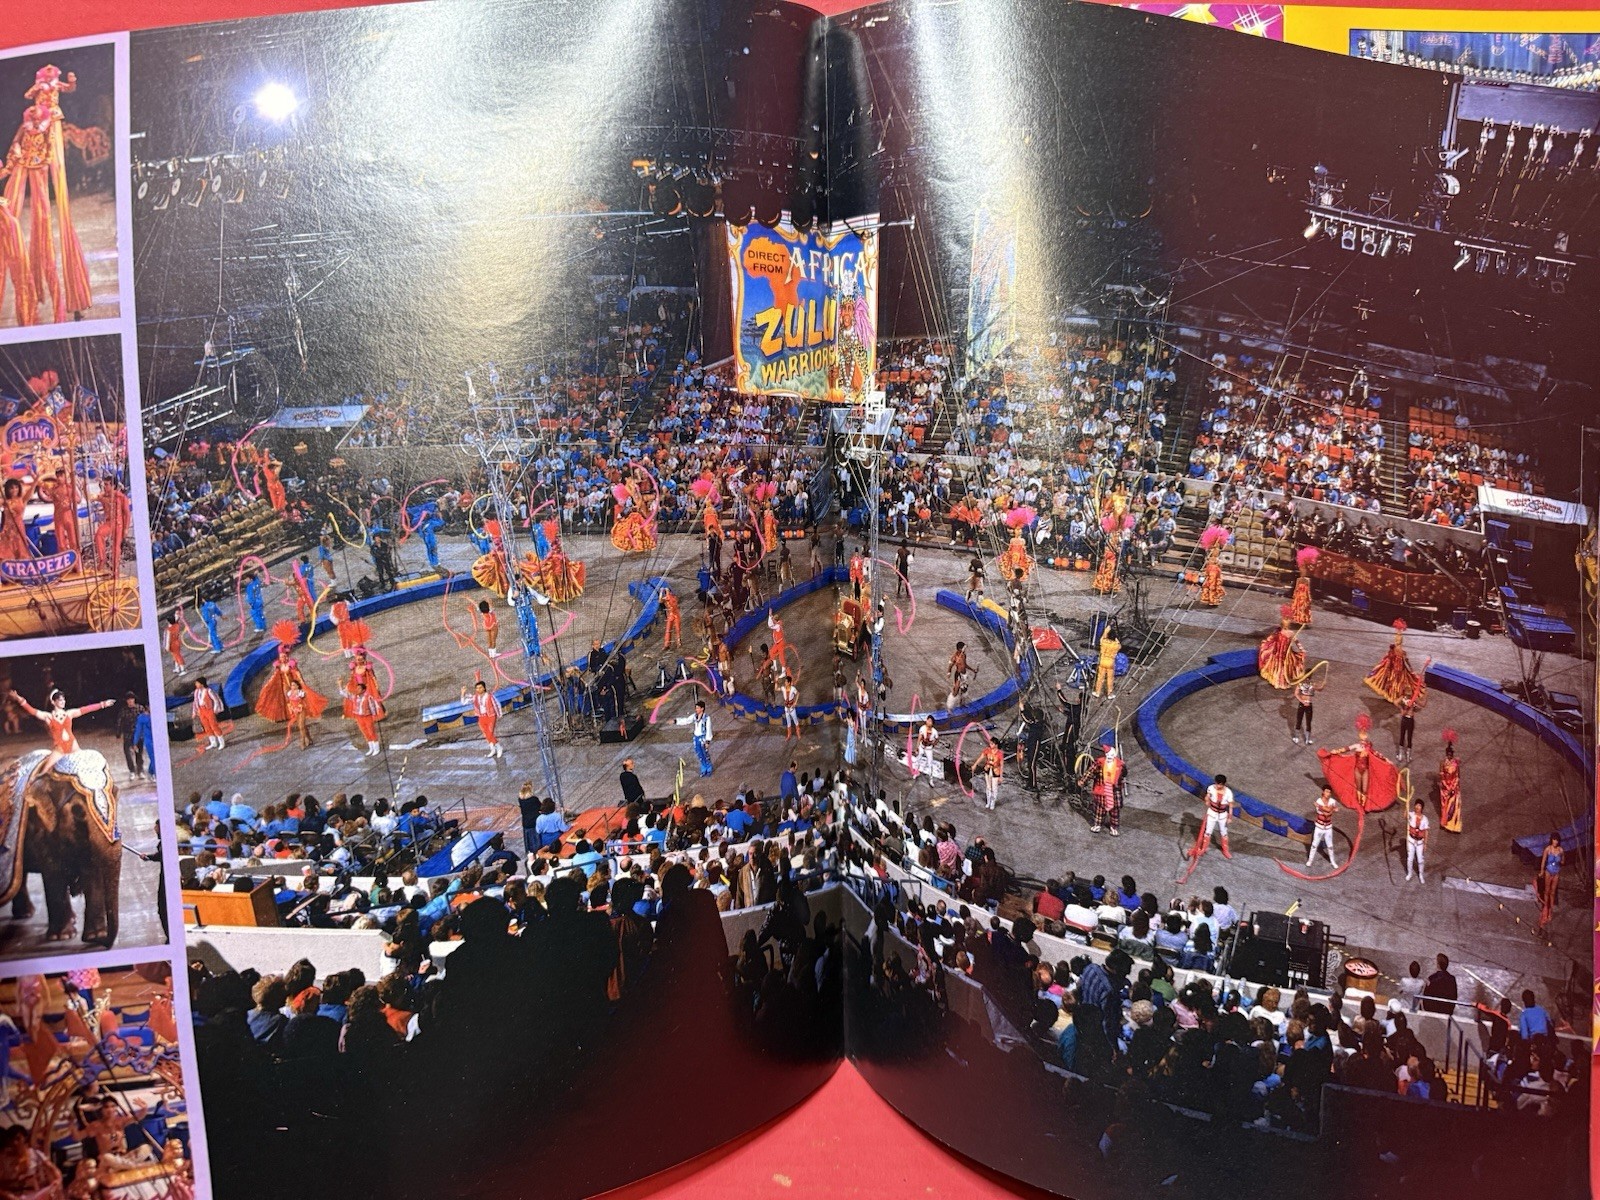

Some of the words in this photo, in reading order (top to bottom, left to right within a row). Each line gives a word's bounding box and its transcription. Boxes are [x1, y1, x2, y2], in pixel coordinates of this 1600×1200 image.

[748, 250, 786, 262] DIRECT
[753, 264, 783, 274] FROM
[784, 247, 873, 291] AFRICA
[755, 295, 837, 357] ZULU
[761, 347, 836, 385] WARRIORS
[12, 424, 50, 442] FLYING
[5, 553, 71, 576] TRAPEZE
